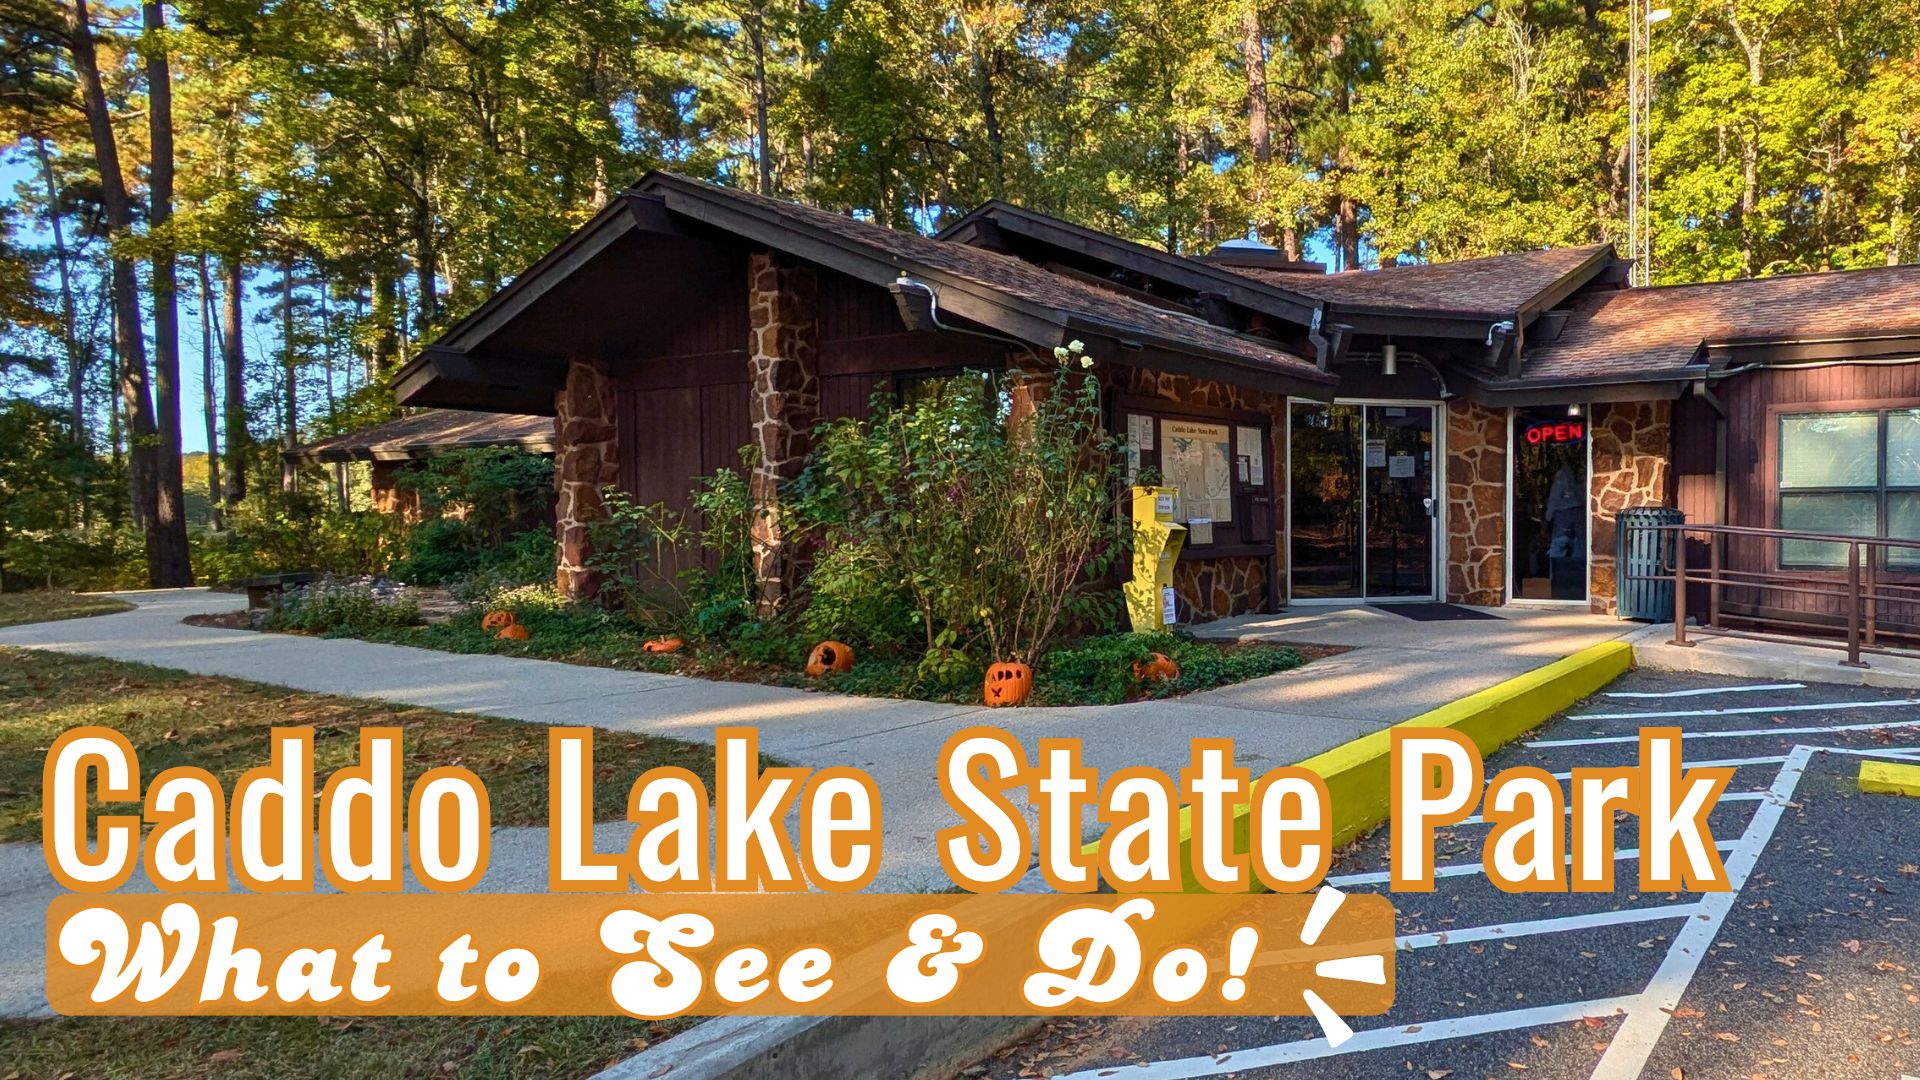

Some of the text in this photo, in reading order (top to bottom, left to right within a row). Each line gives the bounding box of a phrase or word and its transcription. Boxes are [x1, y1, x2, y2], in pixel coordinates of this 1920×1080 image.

[1187, 426, 1197, 435] Lake
[1209, 428, 1218, 436] Park
[1526, 424, 1583, 443] OPEN
